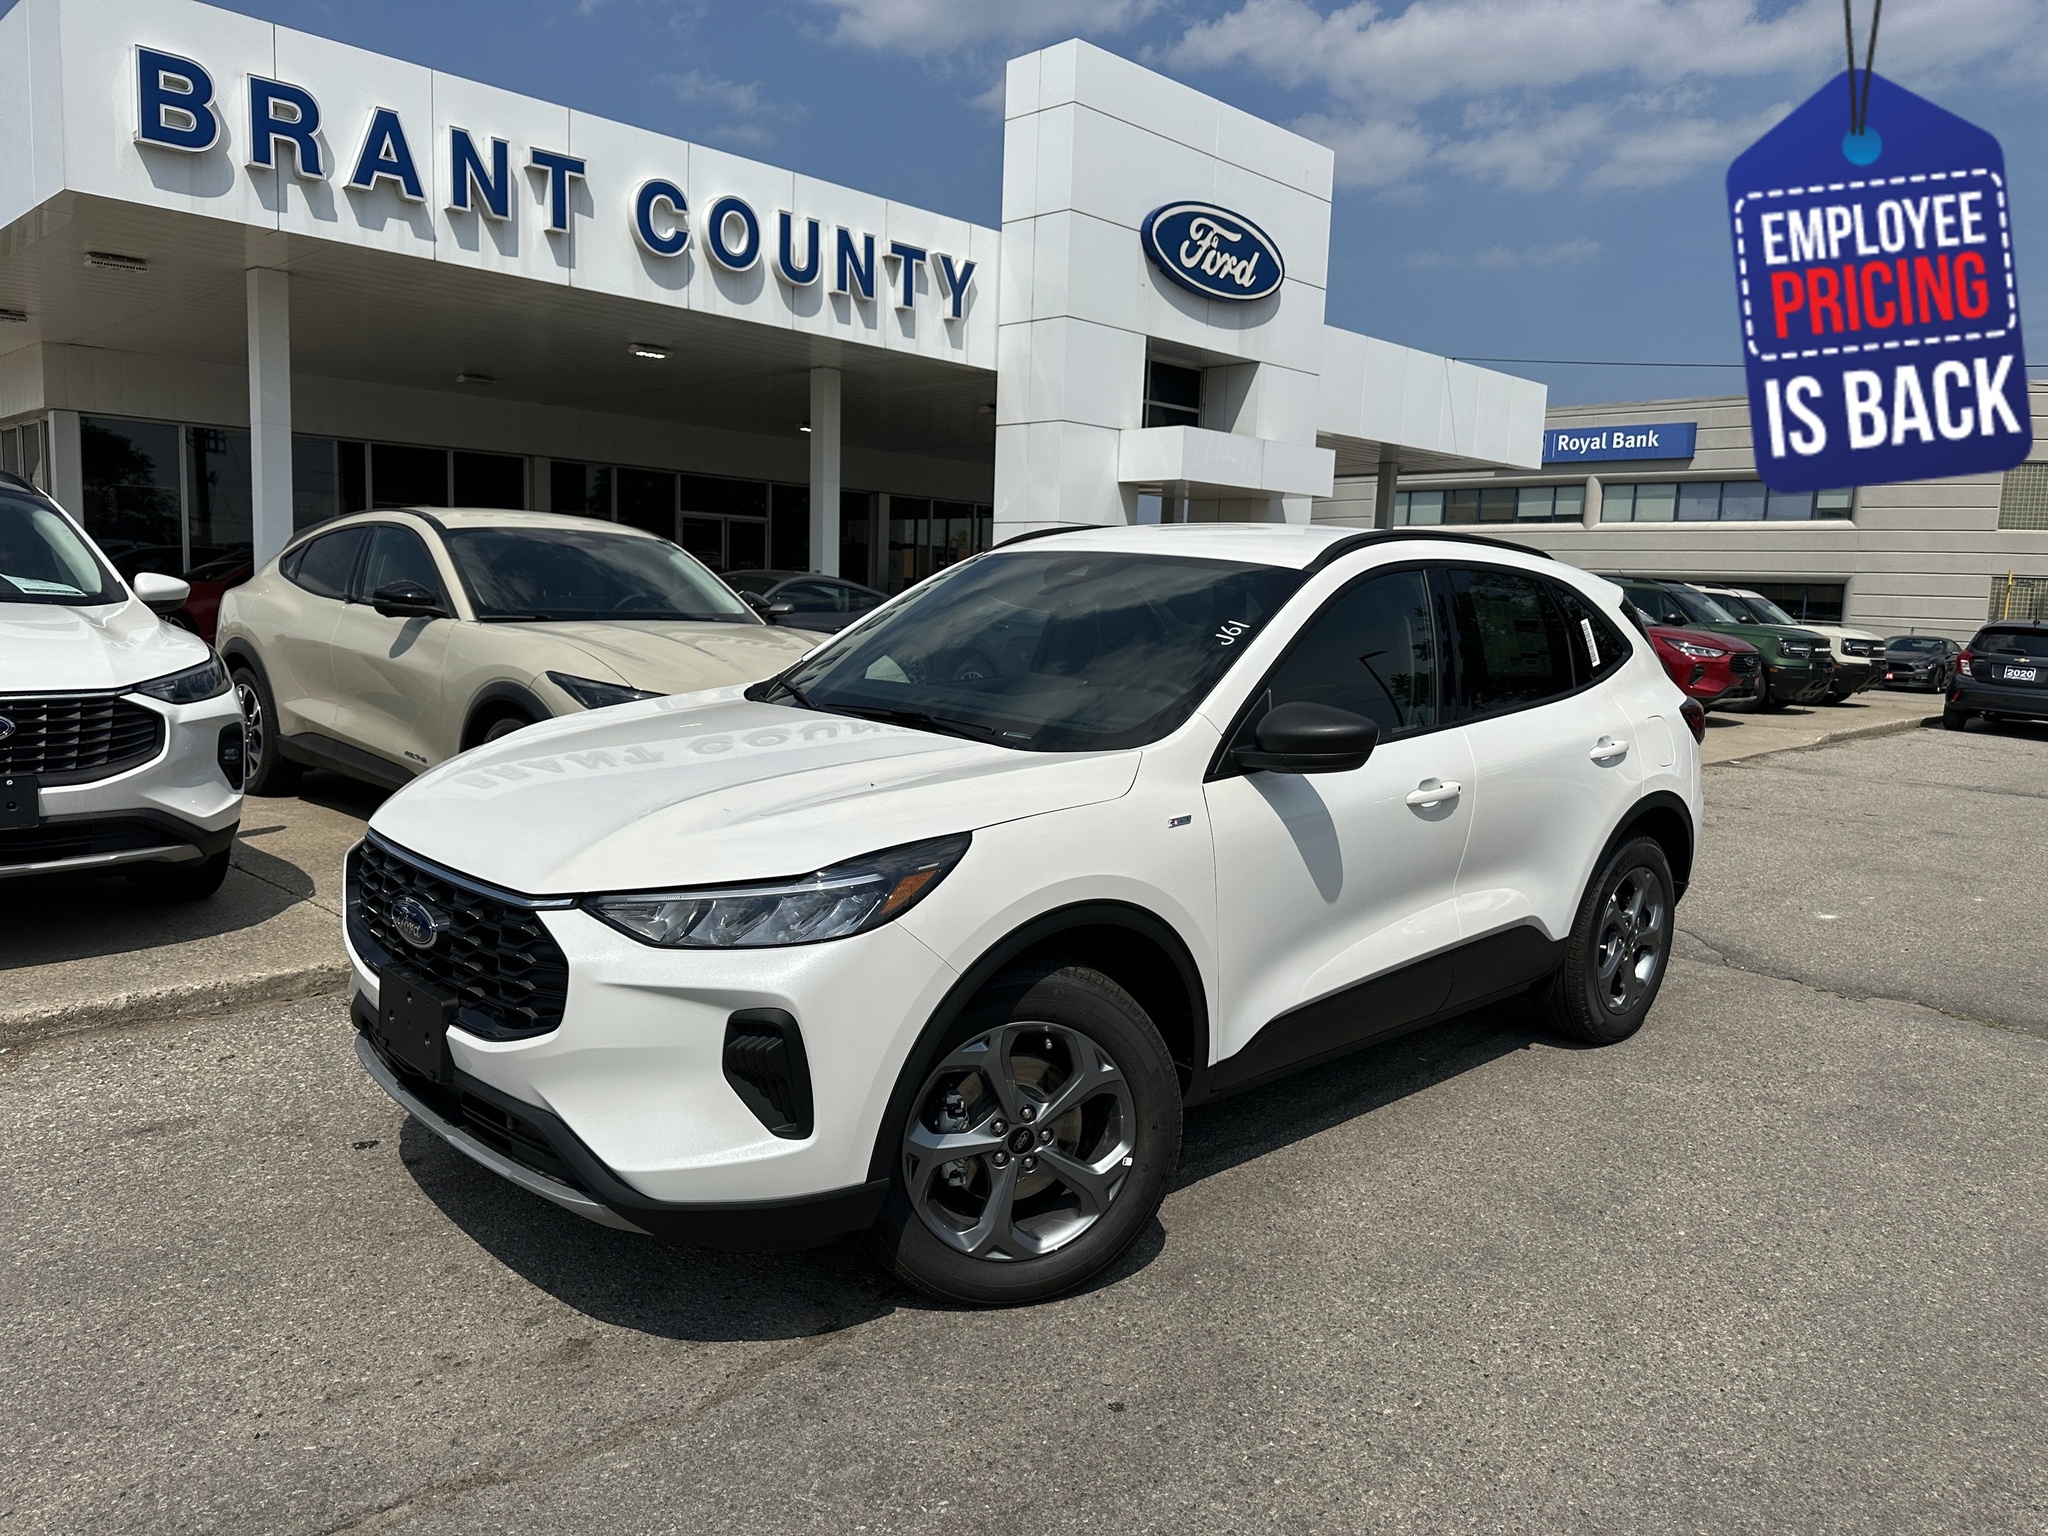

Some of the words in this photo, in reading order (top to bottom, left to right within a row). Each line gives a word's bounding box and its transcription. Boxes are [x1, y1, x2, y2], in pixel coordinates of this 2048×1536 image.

[132, 43, 588, 233] BRANT
[628, 178, 978, 322] COUNTY
[1180, 217, 1260, 288] Ford
[1557, 432, 1607, 455] Royal
[1612, 429, 1660, 449] Bank
[1215, 619, 1251, 646] J61
[2006, 668, 2034, 678] 2020
[396, 906, 422, 938] Ford
